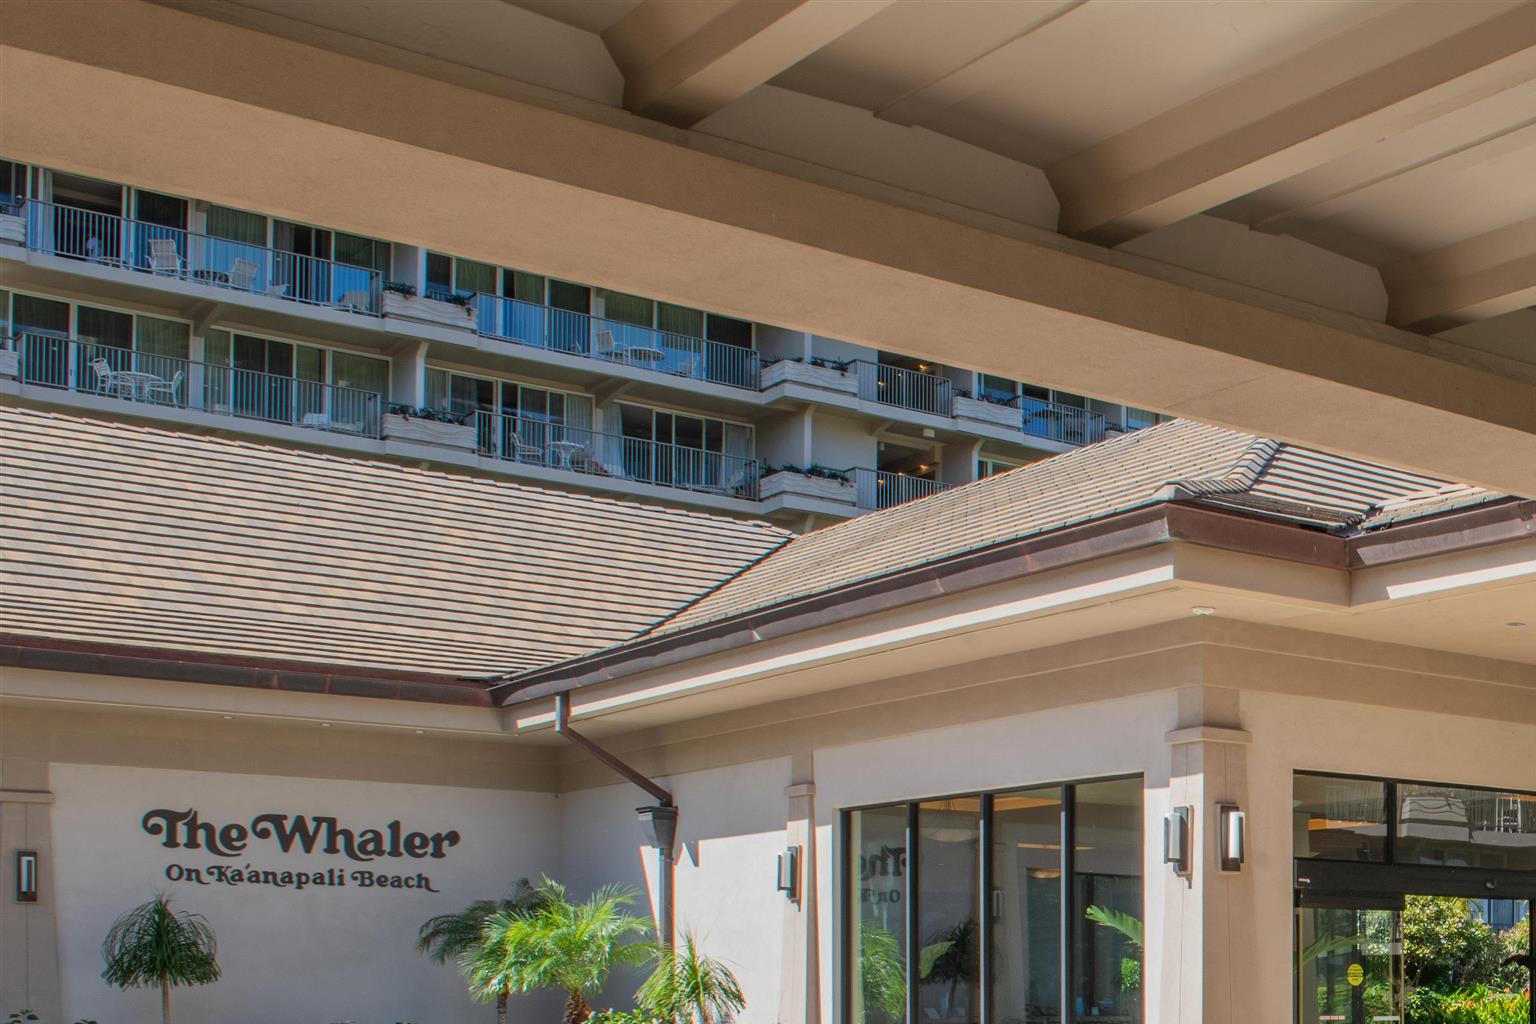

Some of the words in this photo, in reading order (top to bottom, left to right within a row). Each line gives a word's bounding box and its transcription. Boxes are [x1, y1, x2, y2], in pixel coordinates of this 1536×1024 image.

[142, 807, 249, 857] The
[251, 814, 460, 862] Whaler
[165, 863, 210, 885] On
[207, 863, 345, 890] Ka'anapali
[351, 870, 440, 893] Beach
